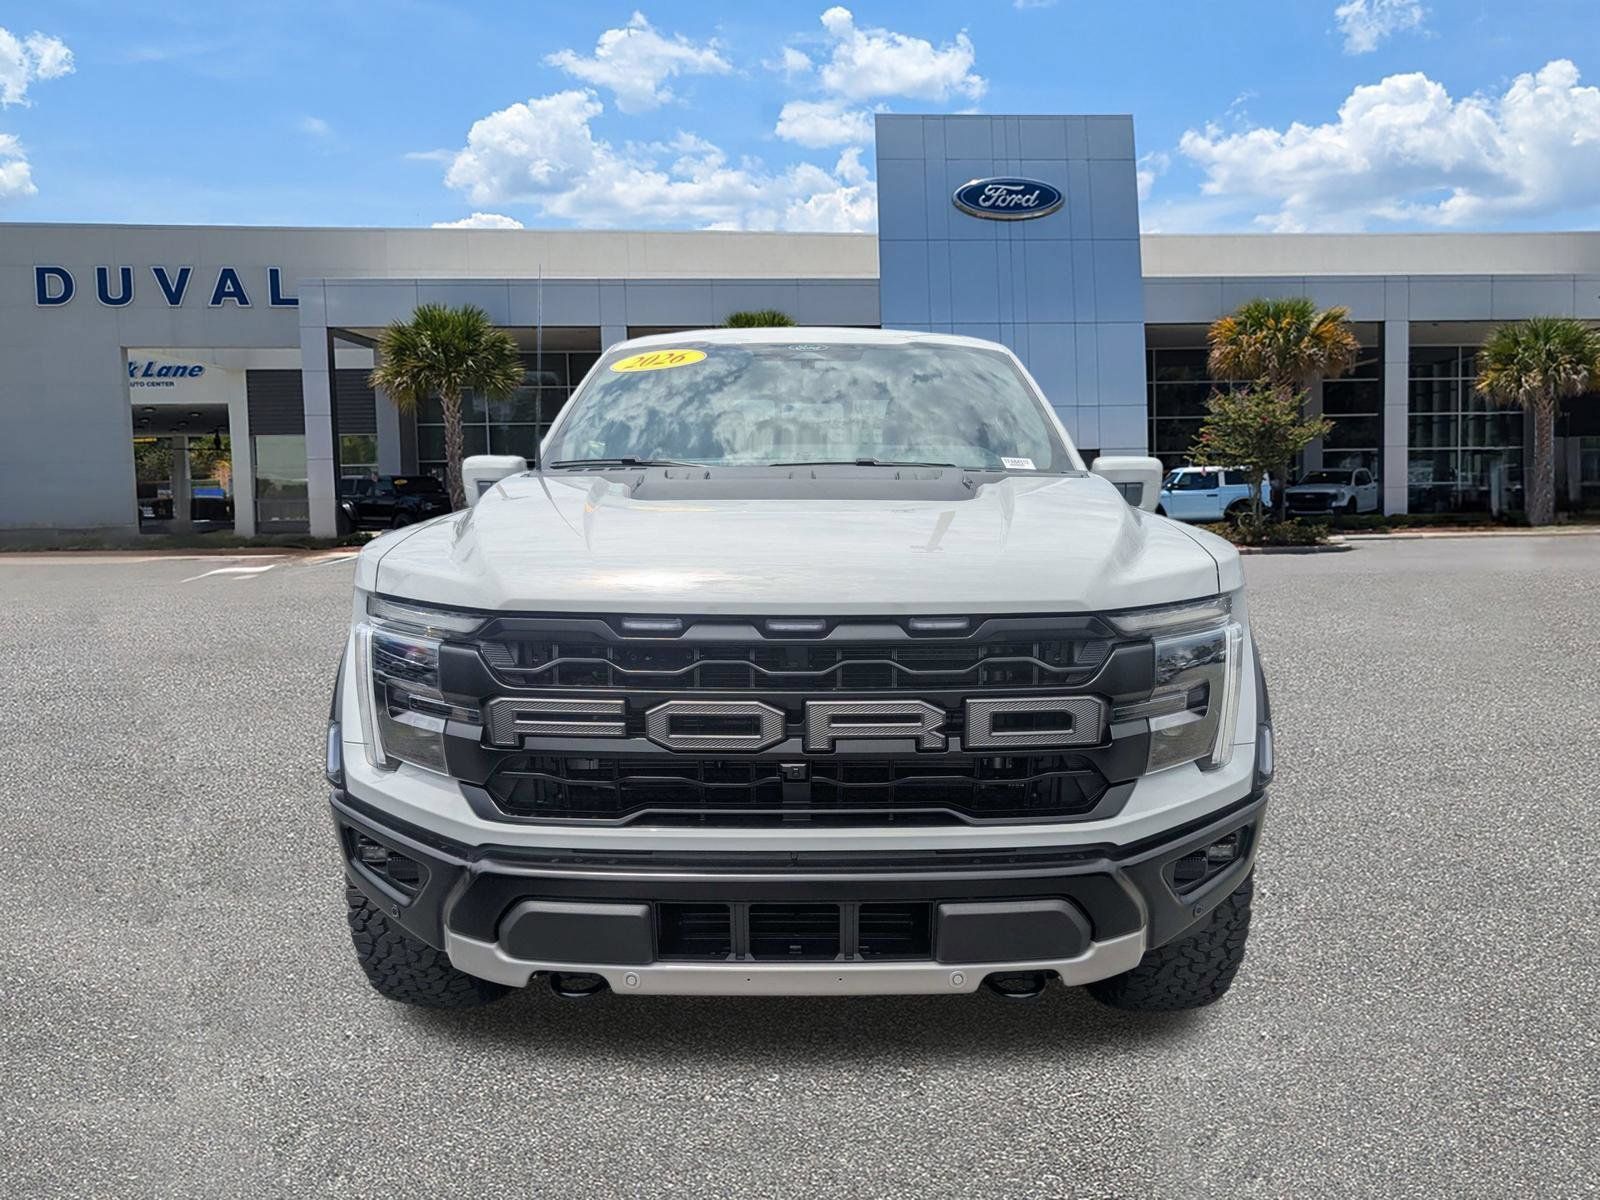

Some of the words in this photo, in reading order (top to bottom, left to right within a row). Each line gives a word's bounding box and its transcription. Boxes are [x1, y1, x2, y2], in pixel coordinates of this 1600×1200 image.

[978, 184, 1041, 208] Ford
[34, 265, 300, 307] DUVAL
[141, 360, 205, 378] Lane
[622, 352, 688, 370] 2026
[146, 380, 176, 388] CENTER
[488, 695, 1107, 752] FORD
